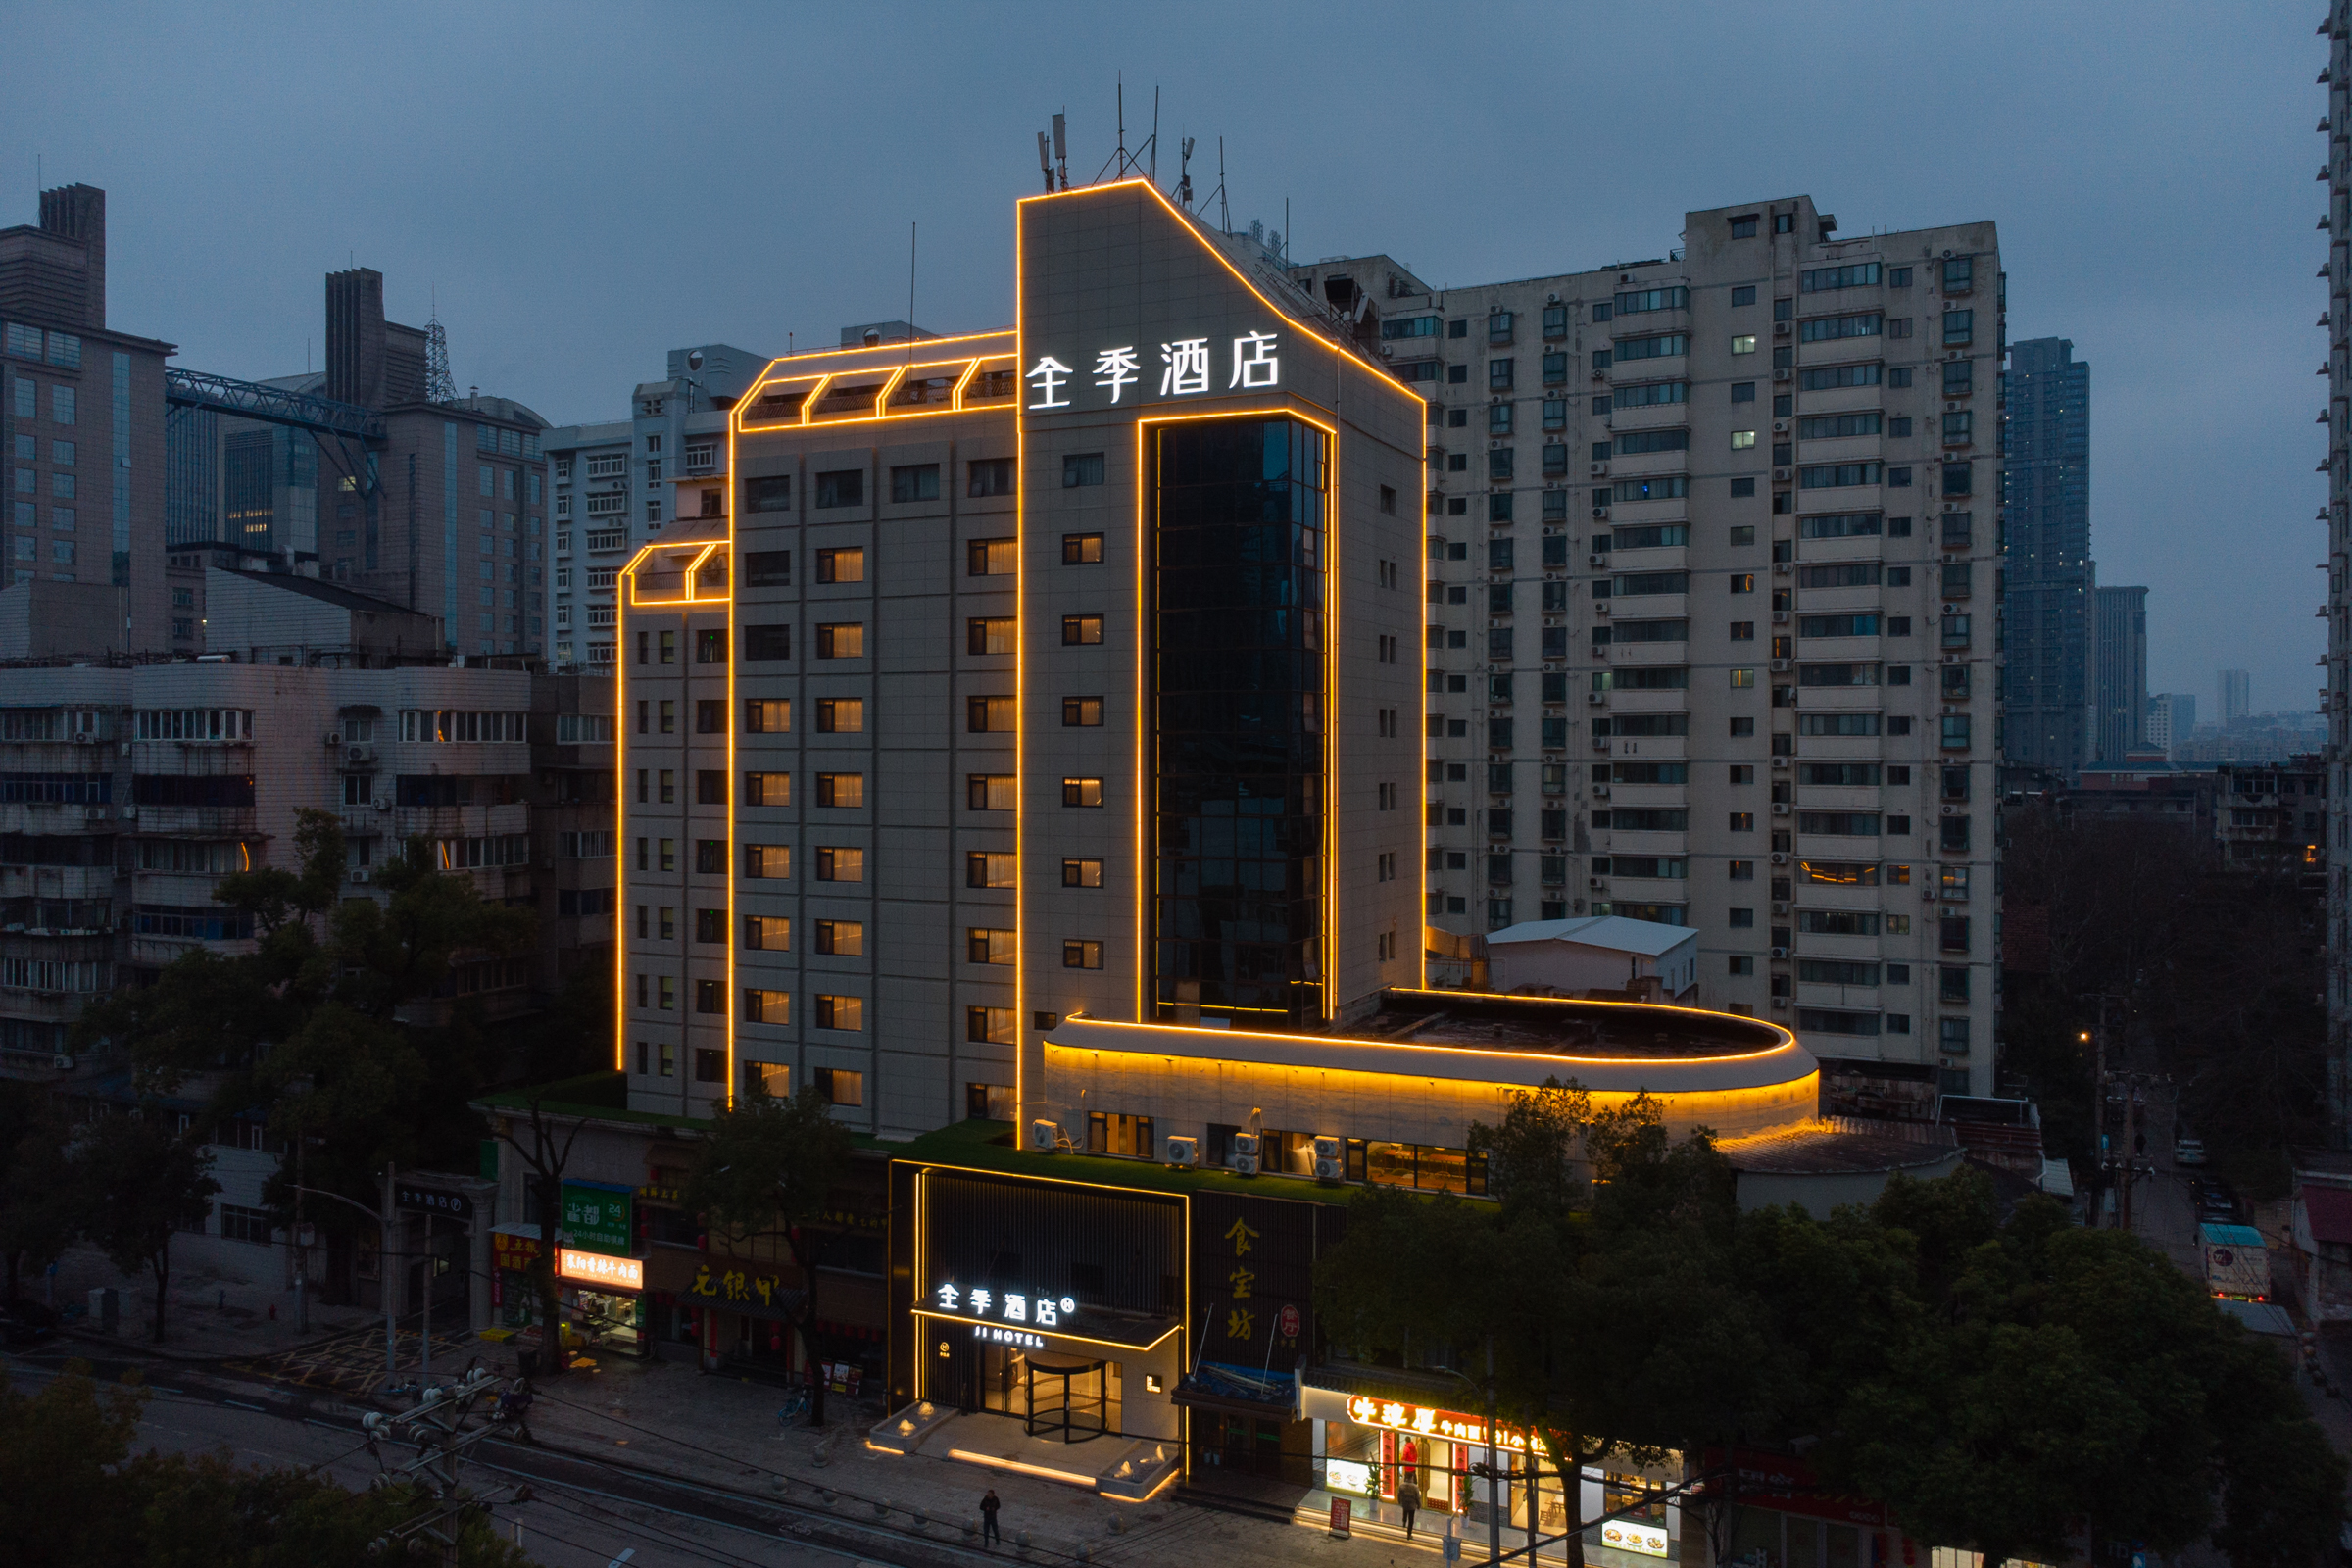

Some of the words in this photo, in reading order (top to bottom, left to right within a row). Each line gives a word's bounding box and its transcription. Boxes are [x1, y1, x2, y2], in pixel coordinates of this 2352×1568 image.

[1025, 331, 1278, 409] 全季酒店
[402, 1190, 447, 1208] 全季酒店
[608, 1203, 622, 1218] 24
[510, 1238, 541, 1257] 五粮
[1225, 1217, 1259, 1340] 食宝坊
[938, 1283, 1057, 1325] 全季酒店
[975, 1325, 988, 1337] JI
[993, 1328, 1044, 1348] HOTEL
